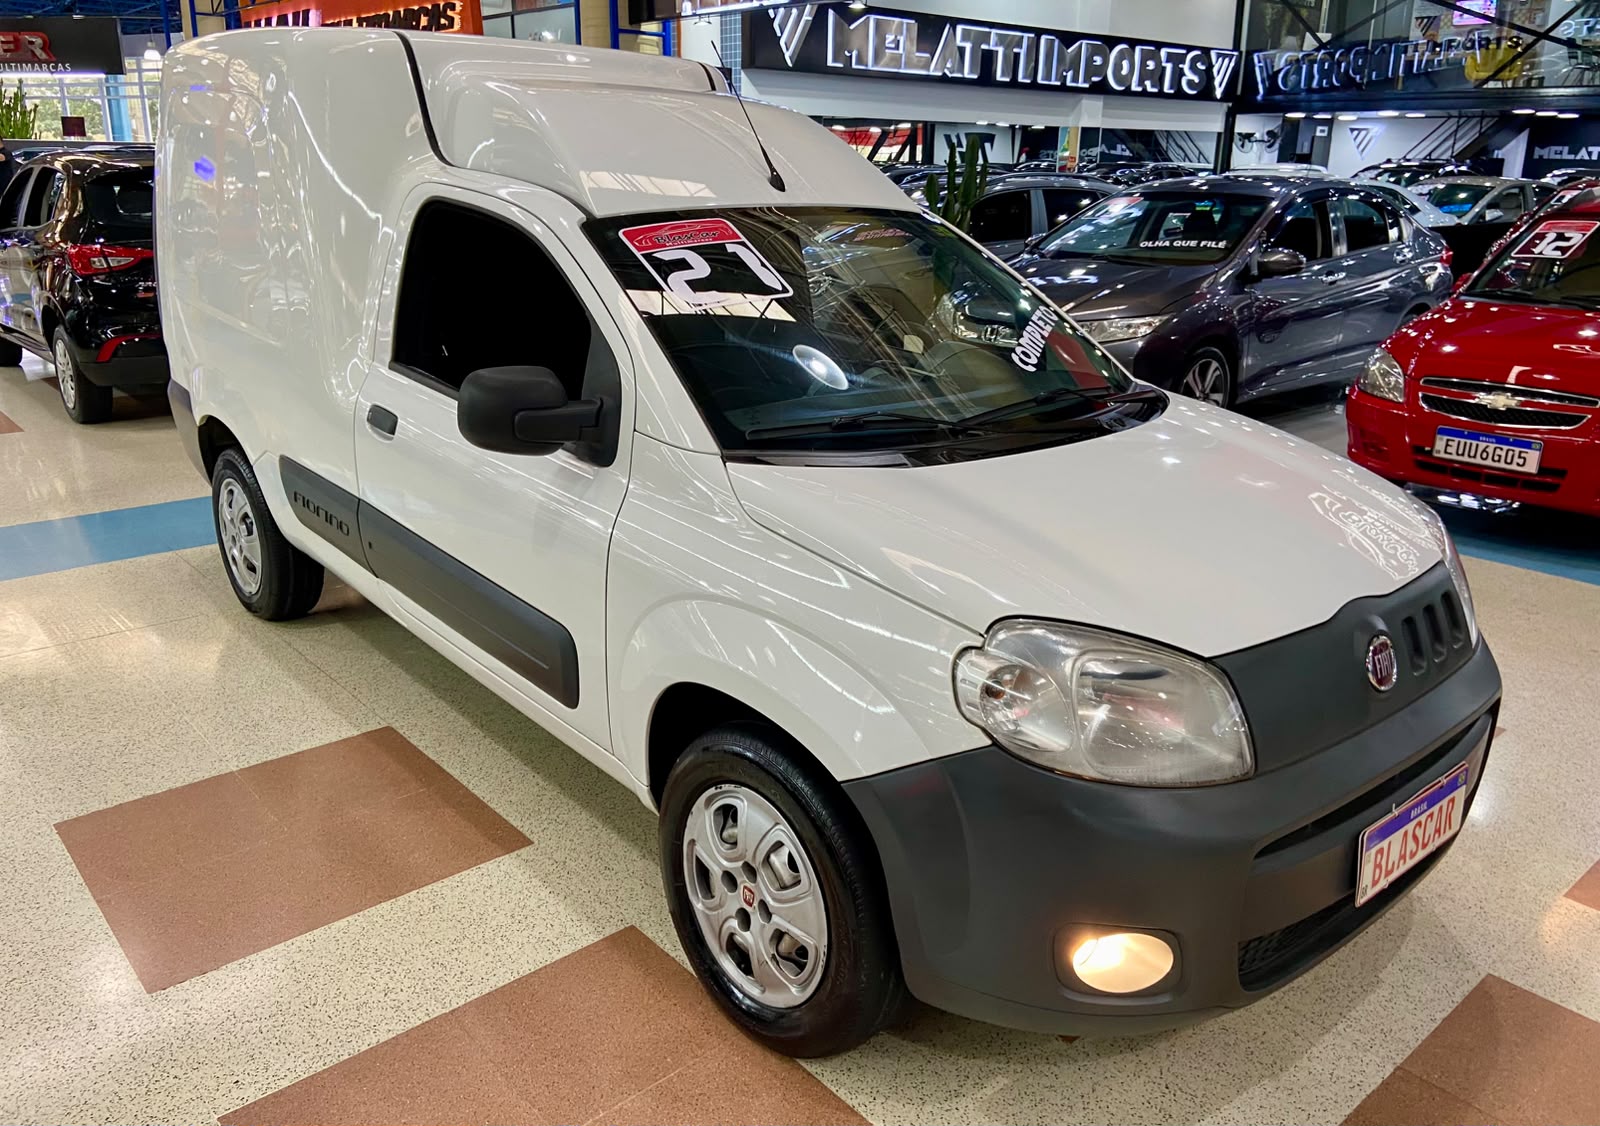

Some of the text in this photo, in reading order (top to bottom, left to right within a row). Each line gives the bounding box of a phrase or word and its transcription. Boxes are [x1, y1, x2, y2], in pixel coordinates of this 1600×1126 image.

[653, 230, 721, 245] BlasCar
[1140, 240, 1227, 249] OLHA QUE FILÉ
[1532, 232, 1584, 256] 12
[651, 243, 783, 307] 21
[1011, 305, 1059, 372] COMPLETO
[1443, 438, 1529, 467] EUU6G05
[293, 490, 350, 537] FIORINO
[1373, 649, 1393, 679] FIAT
[1410, 801, 1428, 820] BRASIL
[1371, 796, 1456, 889] BLASCAR
